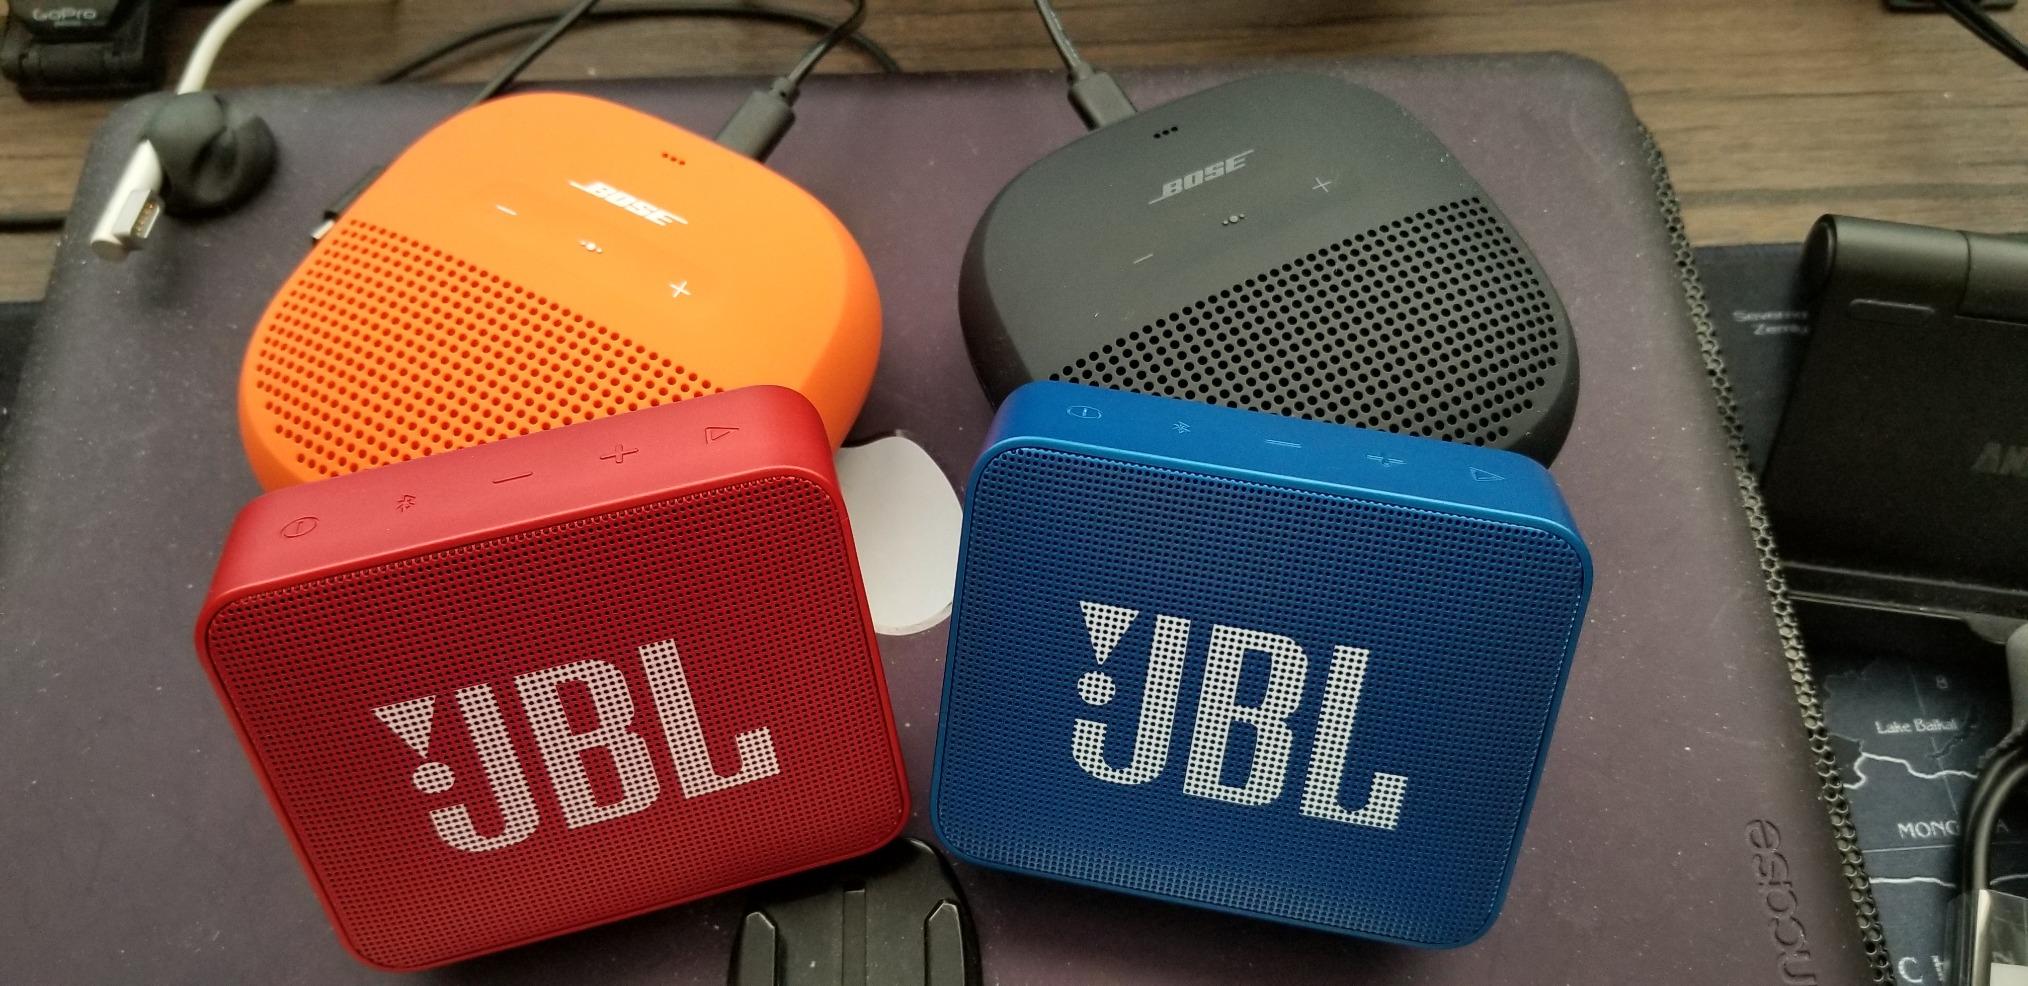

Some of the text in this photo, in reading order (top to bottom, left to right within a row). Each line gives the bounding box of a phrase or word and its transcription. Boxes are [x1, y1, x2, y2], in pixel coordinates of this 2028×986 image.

[32, 7, 97, 21] GoPro
[1147, 149, 1254, 205] BOSE
[567, 180, 688, 227] BOSE
[429, 638, 780, 852] JBL
[1071, 613, 1408, 831] JBL
[1875, 720, 1912, 734] Lake
